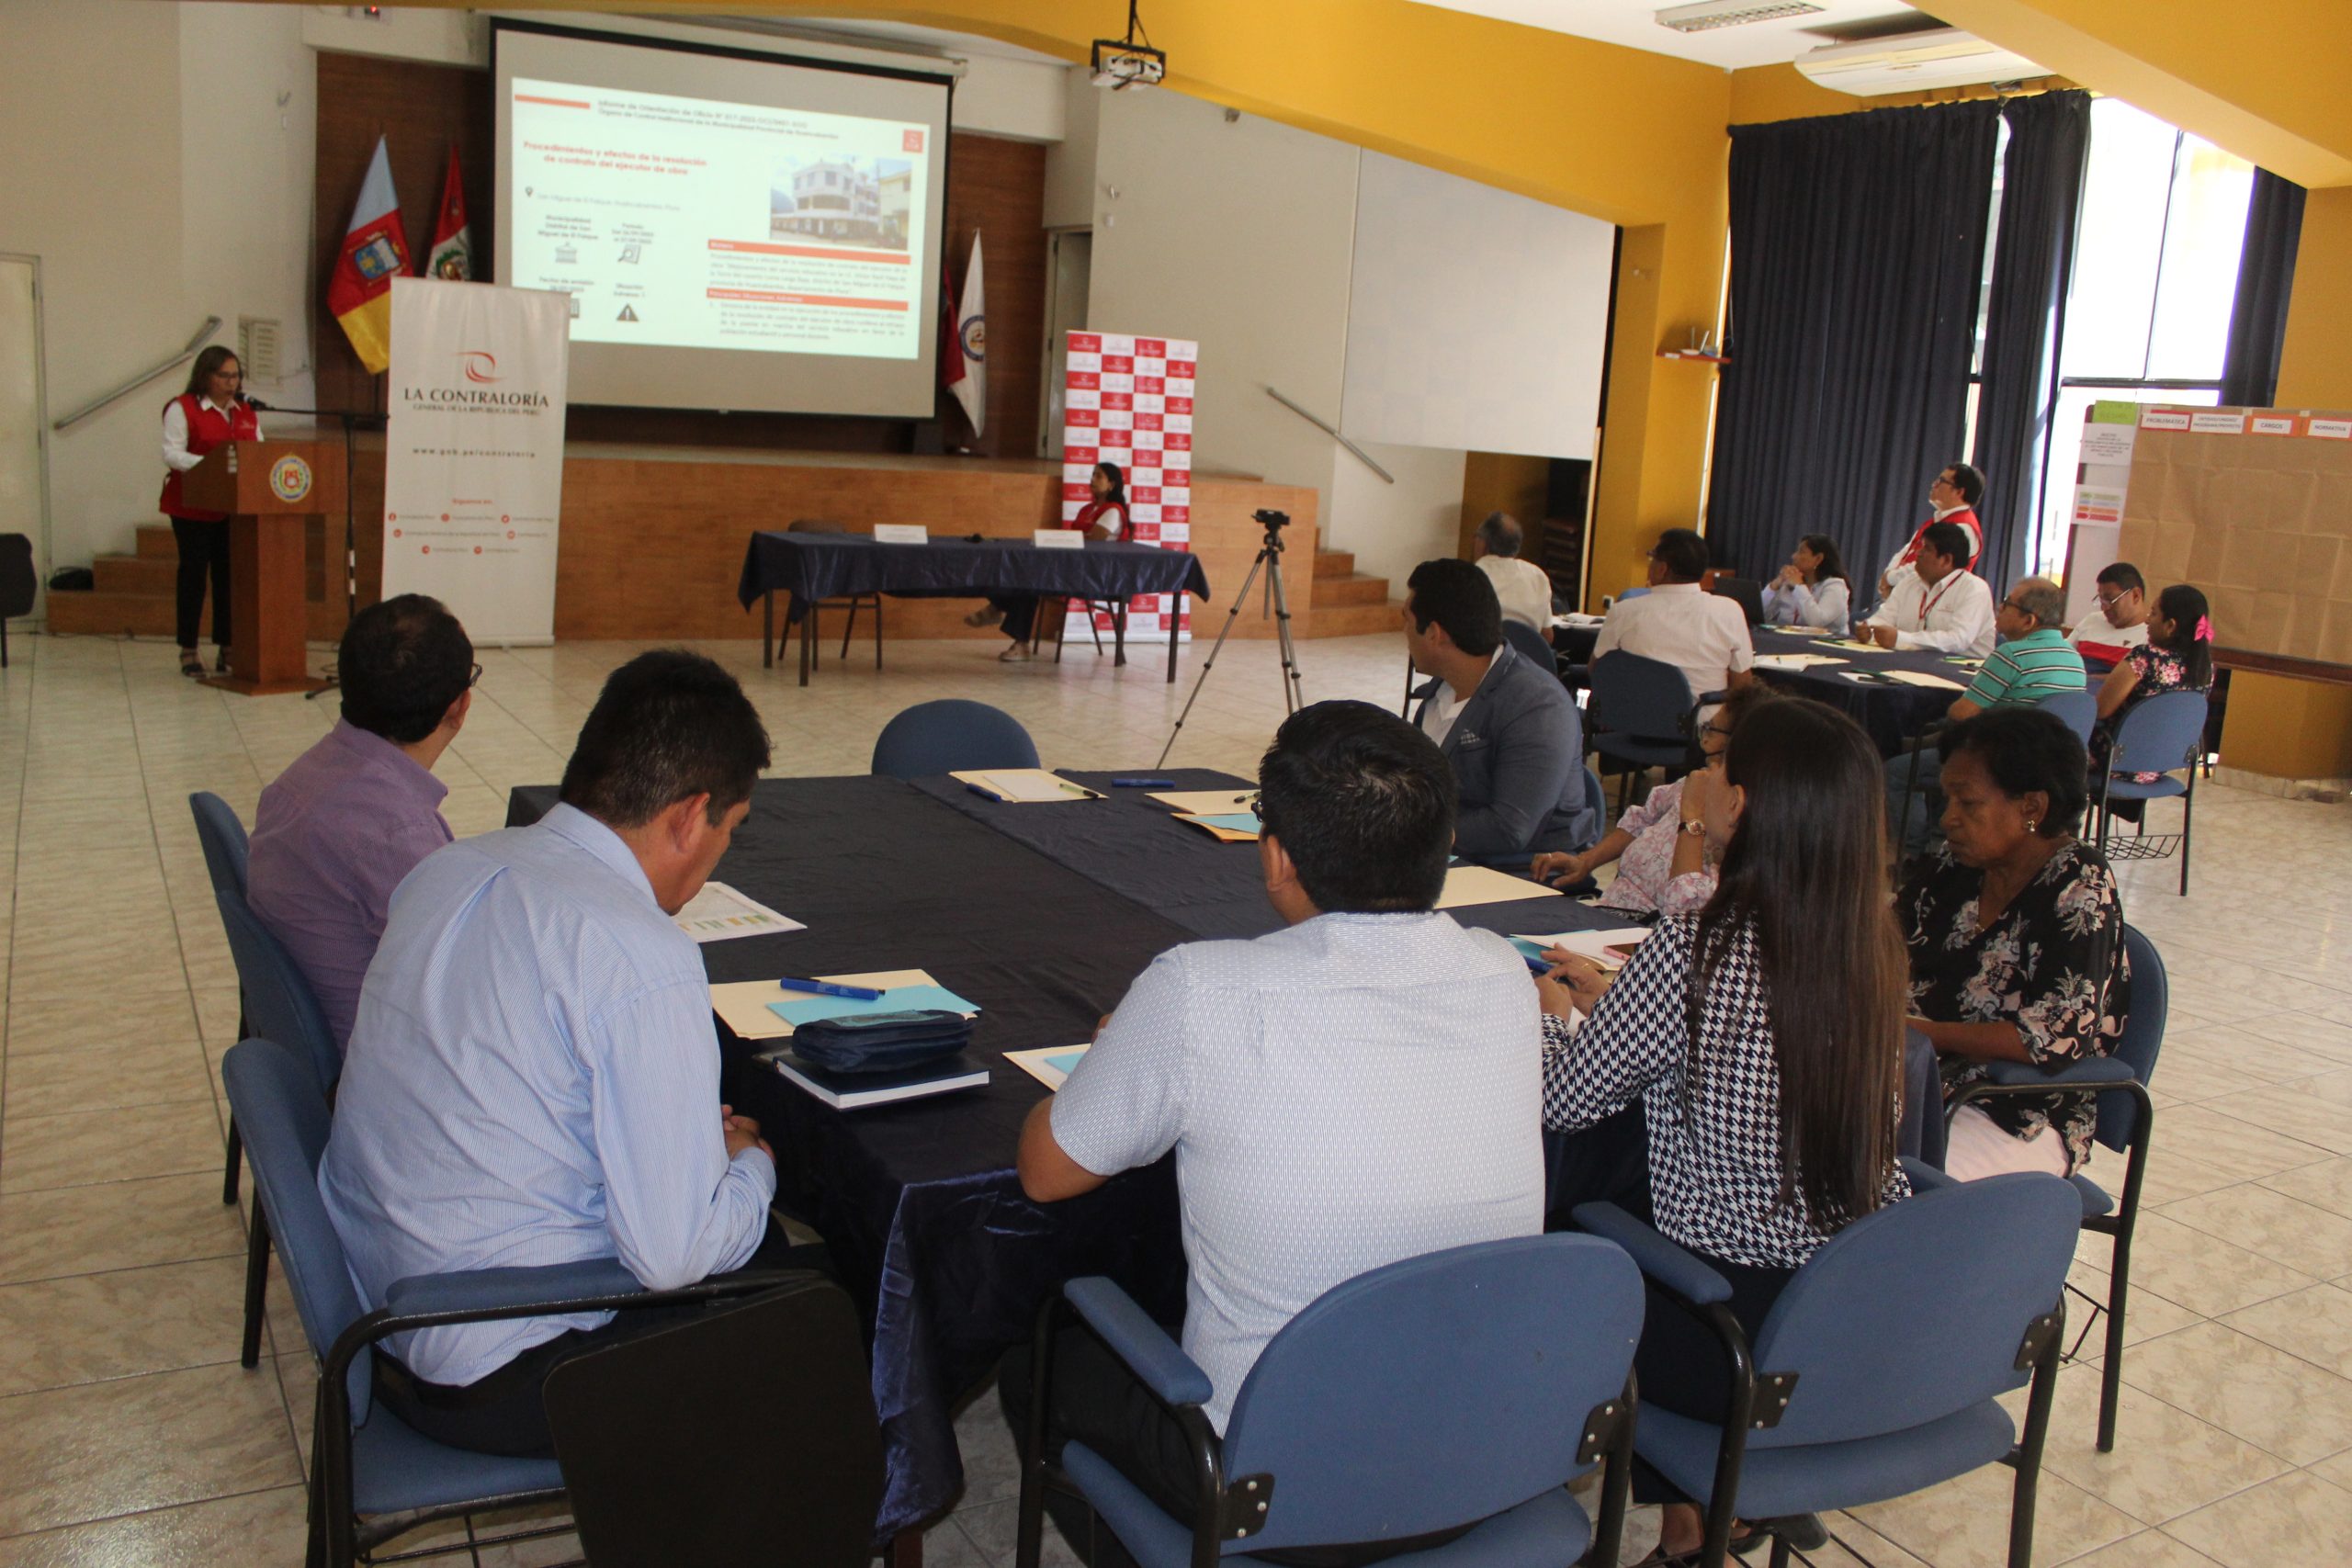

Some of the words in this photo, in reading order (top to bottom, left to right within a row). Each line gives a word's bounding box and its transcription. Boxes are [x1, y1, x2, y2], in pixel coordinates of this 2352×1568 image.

[524, 140, 594, 155] Procedimientos
[604, 149, 636, 160] efectos
[639, 152, 650, 162] de
[544, 153, 556, 163] de
[404, 387, 424, 402] LA
[429, 389, 549, 409] CONTRALORÍA
[2260, 422, 2284, 430] CARGOS
[2314, 423, 2346, 432] NORMATIVA
